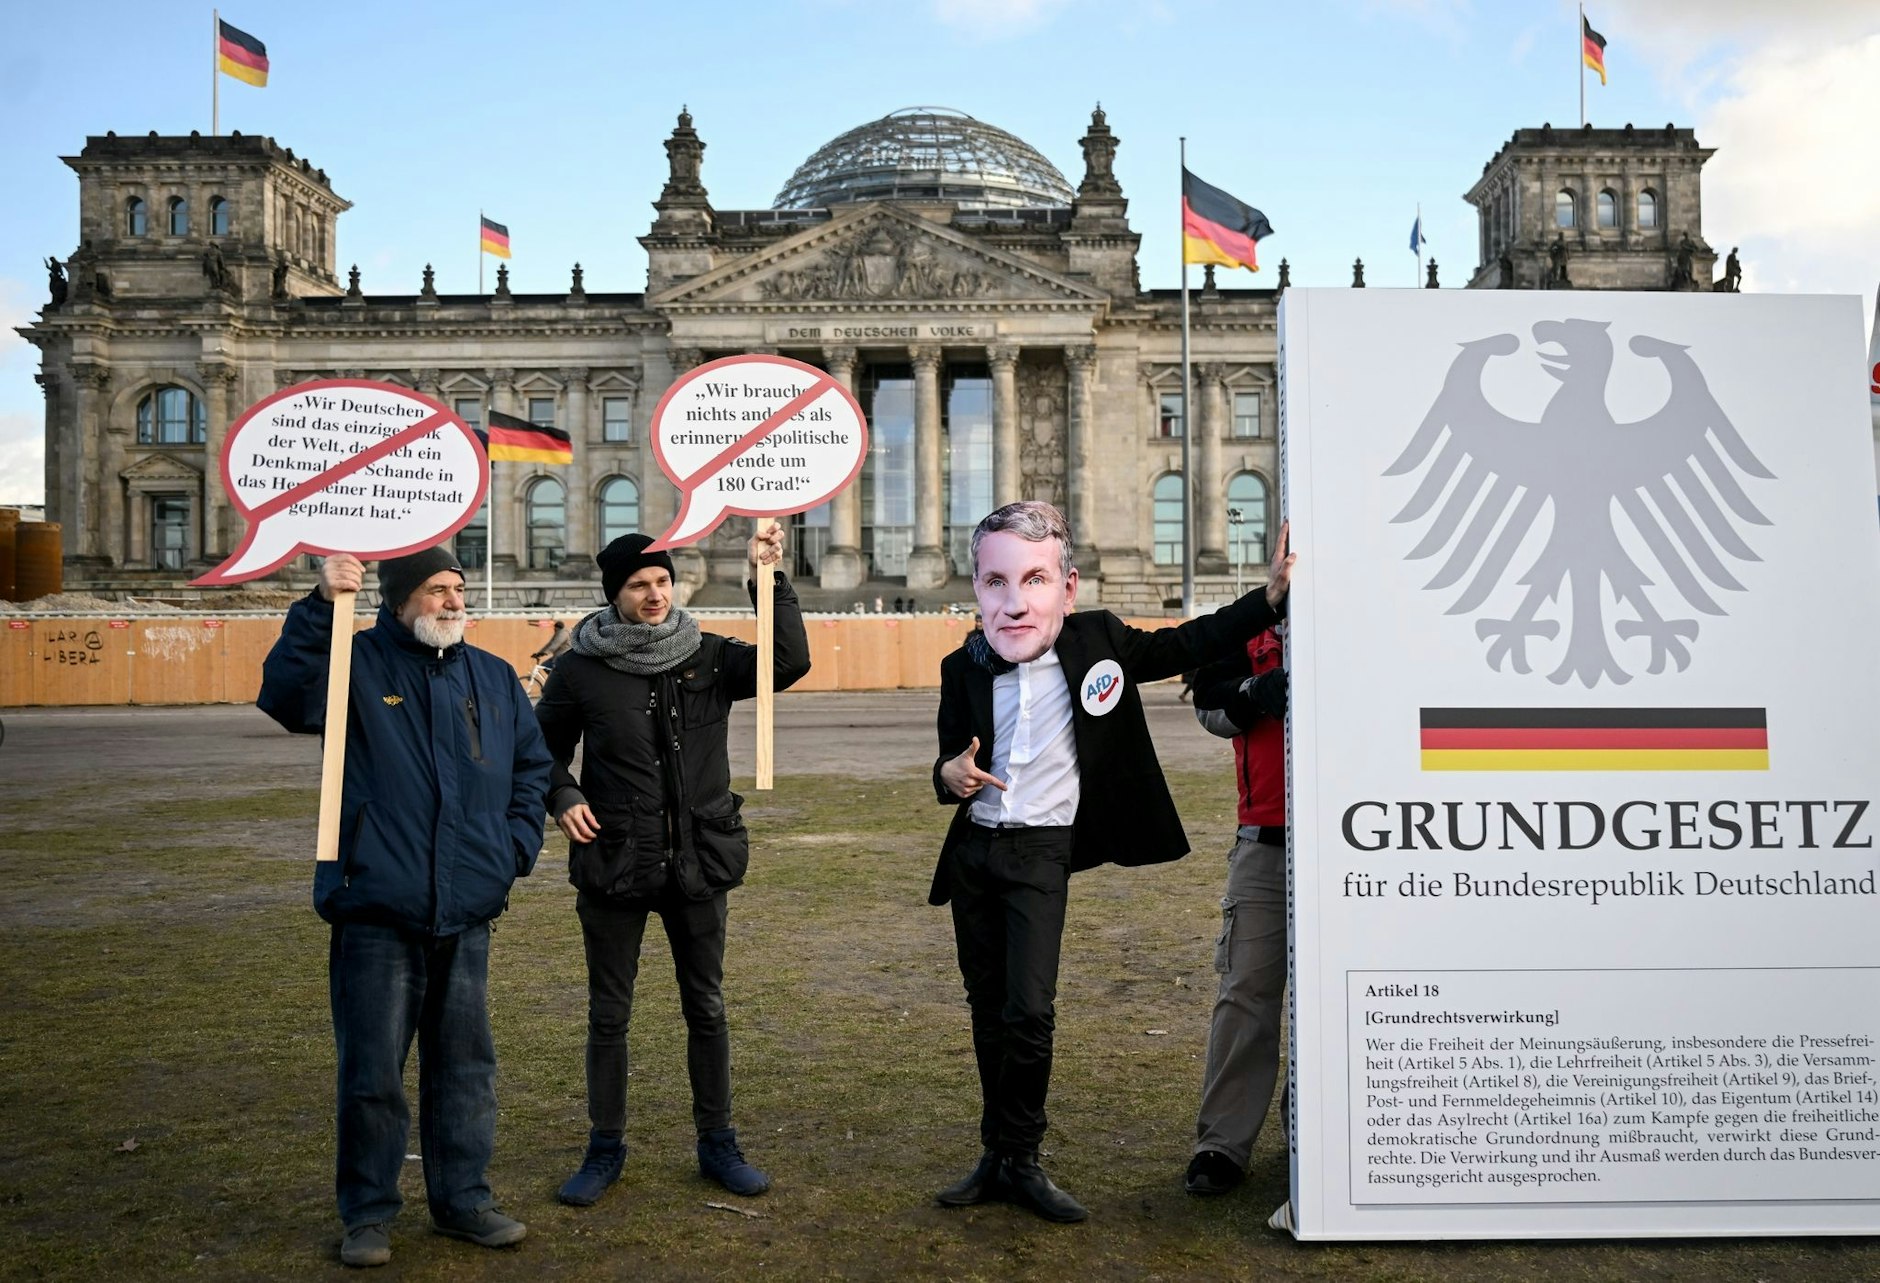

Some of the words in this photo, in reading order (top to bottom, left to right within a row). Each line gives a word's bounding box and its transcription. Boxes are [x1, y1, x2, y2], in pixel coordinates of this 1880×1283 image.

[789, 328, 820, 339] DEM
[834, 327, 917, 339] DEUTSCHEN
[930, 326, 975, 337] VOLKE
[744, 383, 810, 398] brauch
[341, 399, 424, 418] Deutschen
[687, 407, 736, 420] nichts
[742, 408, 804, 421] andes
[811, 408, 831, 421] als
[273, 415, 306, 428] sind
[312, 418, 339, 431] das
[344, 422, 400, 439] einzige
[268, 435, 296, 448] der
[303, 437, 344, 453] Welt,
[350, 441, 373, 454] da
[418, 448, 440, 460] ein
[671, 430, 849, 448] erinneruspolitische
[252, 454, 327, 473] Denkmal
[365, 464, 433, 481] Schande
[439, 469, 452, 481] in
[718, 453, 775, 468] ende
[781, 458, 805, 467] um
[238, 475, 265, 488] das
[272, 477, 305, 492] He
[372, 485, 463, 504] Hauptstadt
[718, 477, 745, 491] 180
[289, 502, 364, 518] gepflanzt
[1087, 674, 1112, 700] AfD
[1342, 801, 1872, 851] GRUNDGESETZ
[1344, 872, 1387, 896] für
[1399, 872, 1442, 896] die
[1453, 872, 1684, 905] Bundesrepublik
[1694, 870, 1876, 895] Deutschland
[1366, 985, 1417, 996] Artikel
[1424, 985, 1439, 996] 18
[1366, 1010, 1558, 1026] [Grundrechtsverwirkung]
[1366, 1039, 1395, 1051] Wer
[1401, 1038, 1423, 1050] die
[1430, 1037, 1484, 1050] Freiheit
[1490, 1038, 1514, 1050] der
[1520, 1036, 1665, 1053] Meinungsäußerung,
[1672, 1035, 1766, 1048] insbesondere
[1772, 1035, 1794, 1047] die
[1800, 1034, 1874, 1047] Pressefrei-
[1366, 1056, 1393, 1069] heit
[1399, 1057, 1454, 1071] (Artikel
[1459, 1057, 1467, 1069] 5
[1472, 1056, 1503, 1069] Abs.
[1510, 1056, 1525, 1070] 1),
[1530, 1056, 1552, 1068] die
[1557, 1054, 1642, 1068] Lehrfreiheit
[1647, 1055, 1702, 1069] (Artikel
[1707, 1055, 1714, 1067] 5
[1719, 1054, 1750, 1066] Abs.
[1755, 1053, 1772, 1068] 3),
[1777, 1054, 1798, 1066] die
[1803, 1054, 1875, 1066] Versamm-
[1367, 1075, 1458, 1092] lungsfreiheit
[1463, 1075, 1518, 1089] (Artikel
[1524, 1074, 1540, 1089] 8),
[1546, 1075, 1568, 1087] die
[1573, 1072, 1718, 1091] Vereinigungsfreiheit
[1723, 1072, 1777, 1087] (Artikel
[1783, 1072, 1799, 1086] 9),
[1805, 1072, 1829, 1084] das
[1834, 1071, 1876, 1085] Brief-,
[1368, 1095, 1403, 1107] Post-
[1409, 1095, 1436, 1107] und
[1443, 1093, 1595, 1110] Fernmeldegeheimnis
[1601, 1092, 1656, 1107] (Artikel
[1662, 1092, 1686, 1106] 10),
[1692, 1092, 1716, 1104] das
[1722, 1092, 1791, 1108] Eigentum
[1796, 1090, 1851, 1105] (Artikel
[1858, 1090, 1878, 1104] 14)
[1367, 1114, 1400, 1126] oder
[1407, 1113, 1432, 1126] das
[1438, 1112, 1508, 1130] Asylrecht
[1514, 1112, 1571, 1127] (Artikel
[1579, 1111, 1607, 1126] 16a)
[1614, 1115, 1645, 1124] zum
[1652, 1111, 1709, 1128] Kampfe
[1715, 1114, 1758, 1127] gegen
[1764, 1110, 1786, 1122] die
[1793, 1108, 1879, 1122] freiheitliche
[1368, 1131, 1477, 1145] demokratische
[1486, 1131, 1600, 1148] Grundordnung
[1609, 1129, 1698, 1144] mißbraucht,
[1707, 1129, 1771, 1142] verwirkt
[1780, 1129, 1817, 1141] diese
[1826, 1128, 1880, 1141] Grund-
[1368, 1151, 1416, 1164] rechte.
[1421, 1152, 1445, 1164] Die
[1451, 1151, 1537, 1167] Verwirkung
[1542, 1150, 1570, 1163] und
[1576, 1149, 1596, 1162] ihr
[1601, 1149, 1660, 1162] Ausmaß
[1665, 1149, 1719, 1161] werden
[1724, 1147, 1766, 1161] durch
[1770, 1148, 1795, 1160] das
[1799, 1147, 1880, 1160] Bundesver-
[1369, 1169, 1483, 1187] fassungsgericht
[1488, 1168, 1600, 1187] ausgesprochen.
